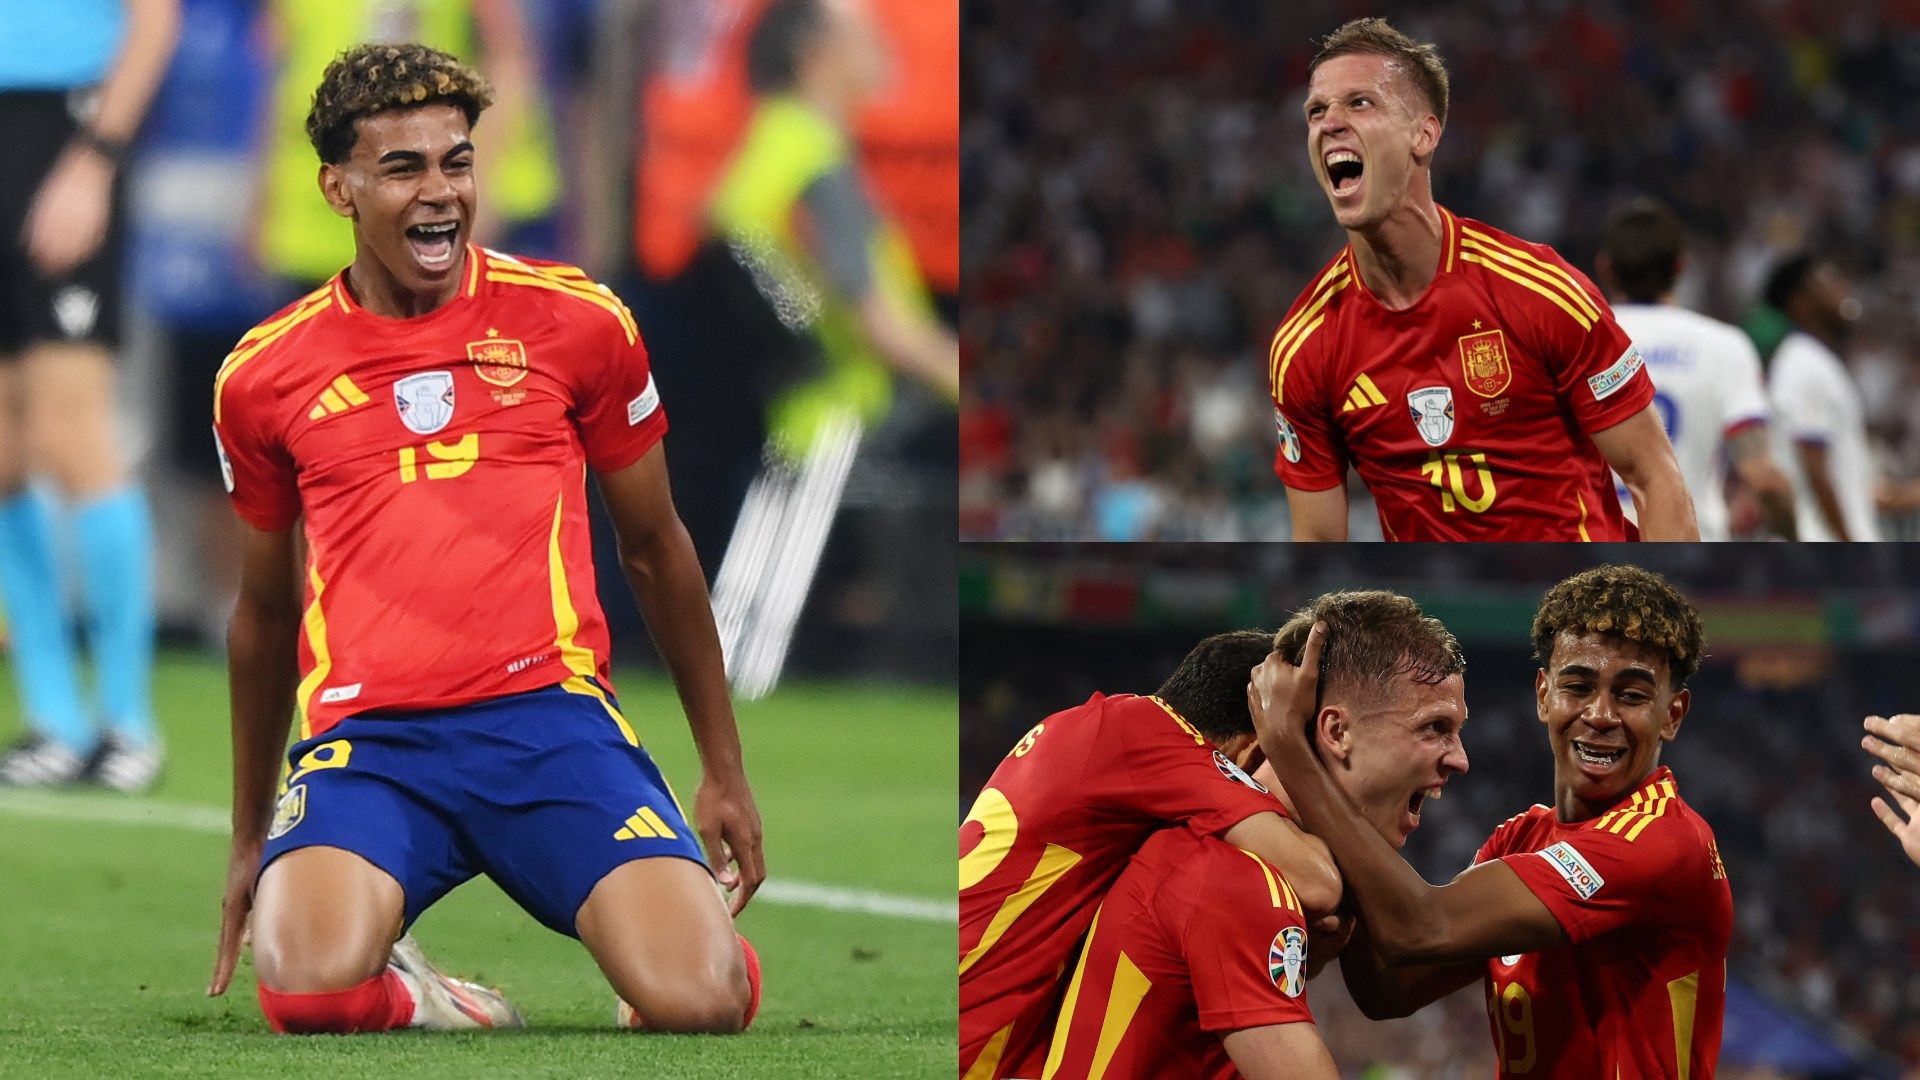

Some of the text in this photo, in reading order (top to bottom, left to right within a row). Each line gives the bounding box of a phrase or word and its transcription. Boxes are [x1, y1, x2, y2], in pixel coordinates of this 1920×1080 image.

[1592, 350, 1640, 393] FOUNDATION
[1421, 450, 1497, 513] 10
[1550, 846, 1598, 894] UNDATION
[1493, 981, 1537, 1074] 19
